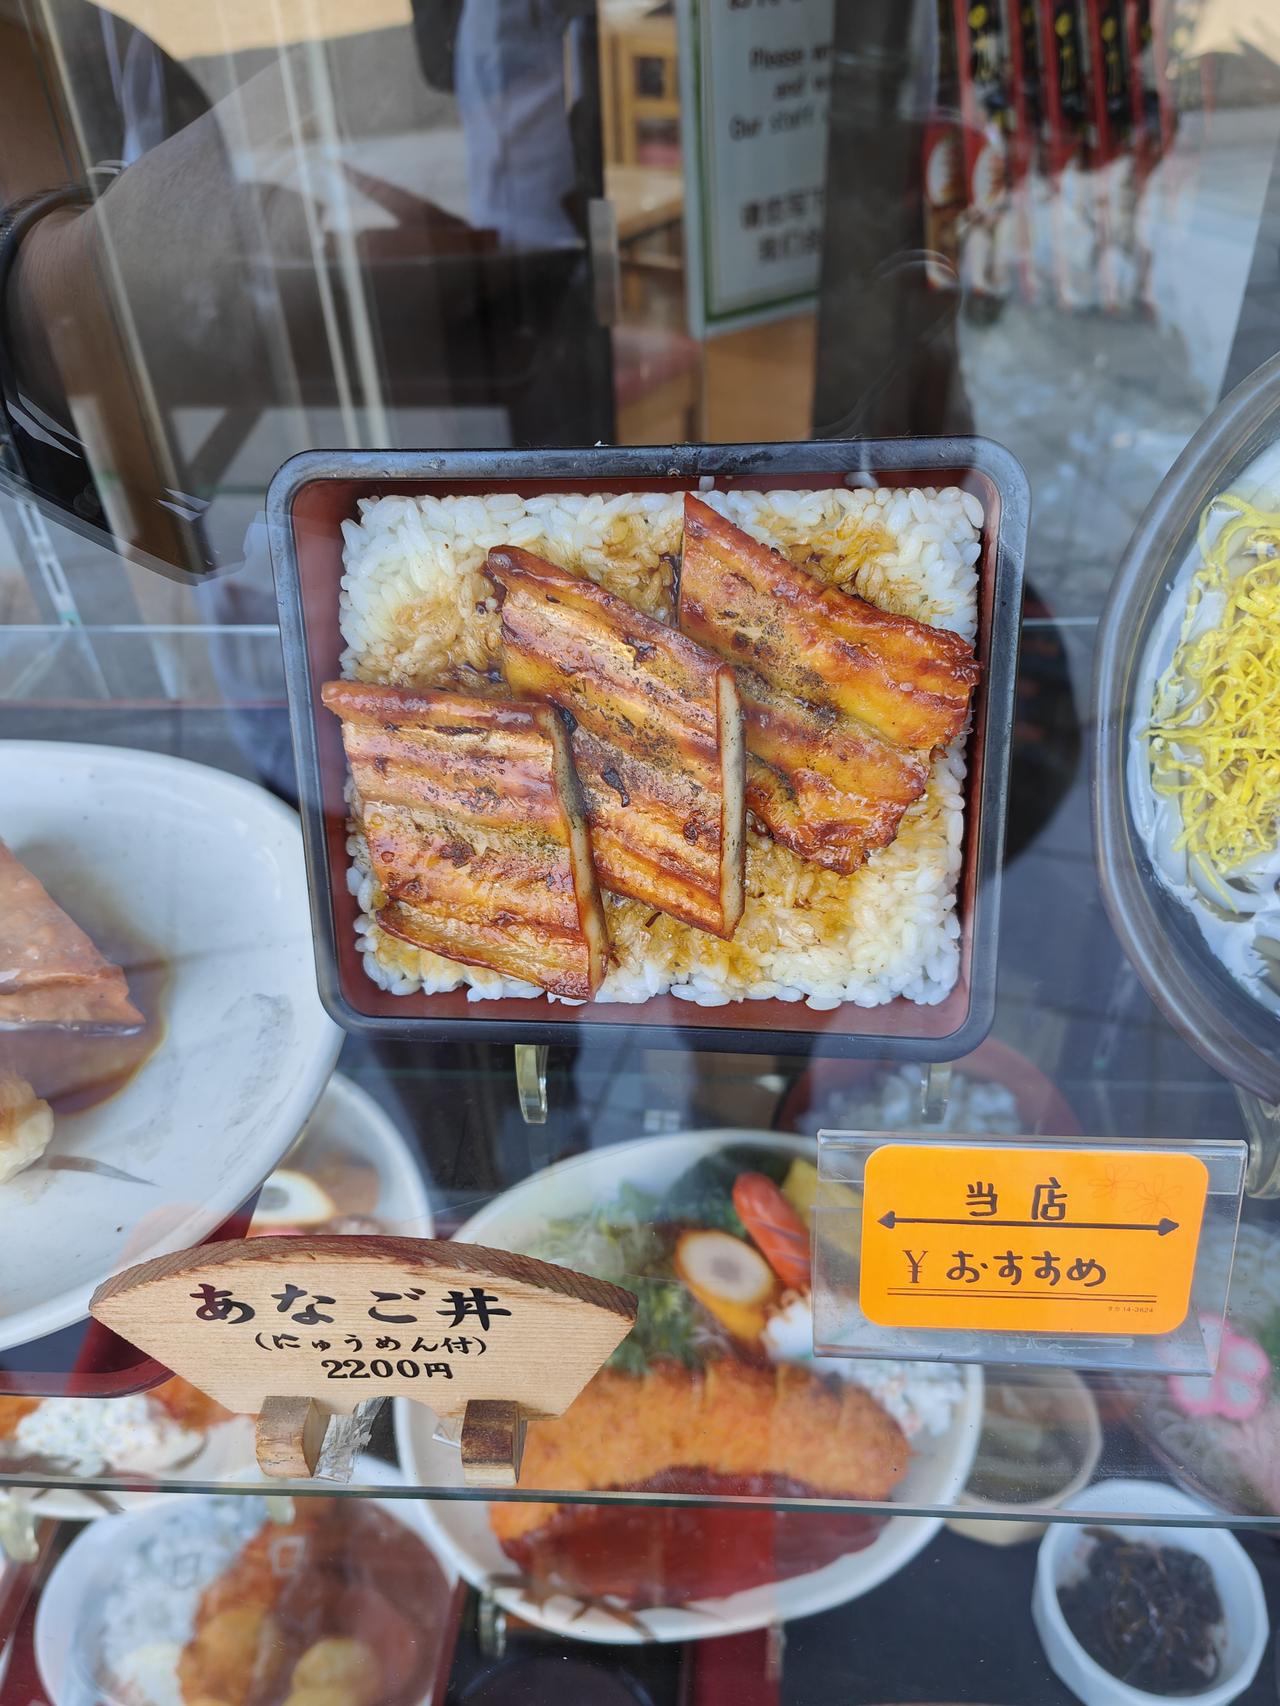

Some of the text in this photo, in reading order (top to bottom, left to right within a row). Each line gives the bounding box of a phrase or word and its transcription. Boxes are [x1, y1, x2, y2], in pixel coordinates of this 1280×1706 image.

[965, 1176, 1068, 1221] 当店
[945, 1249, 1107, 1288] おすすめ
[189, 1282, 512, 1332] あなご丼
[320, 1358, 454, 1380] 2200円
